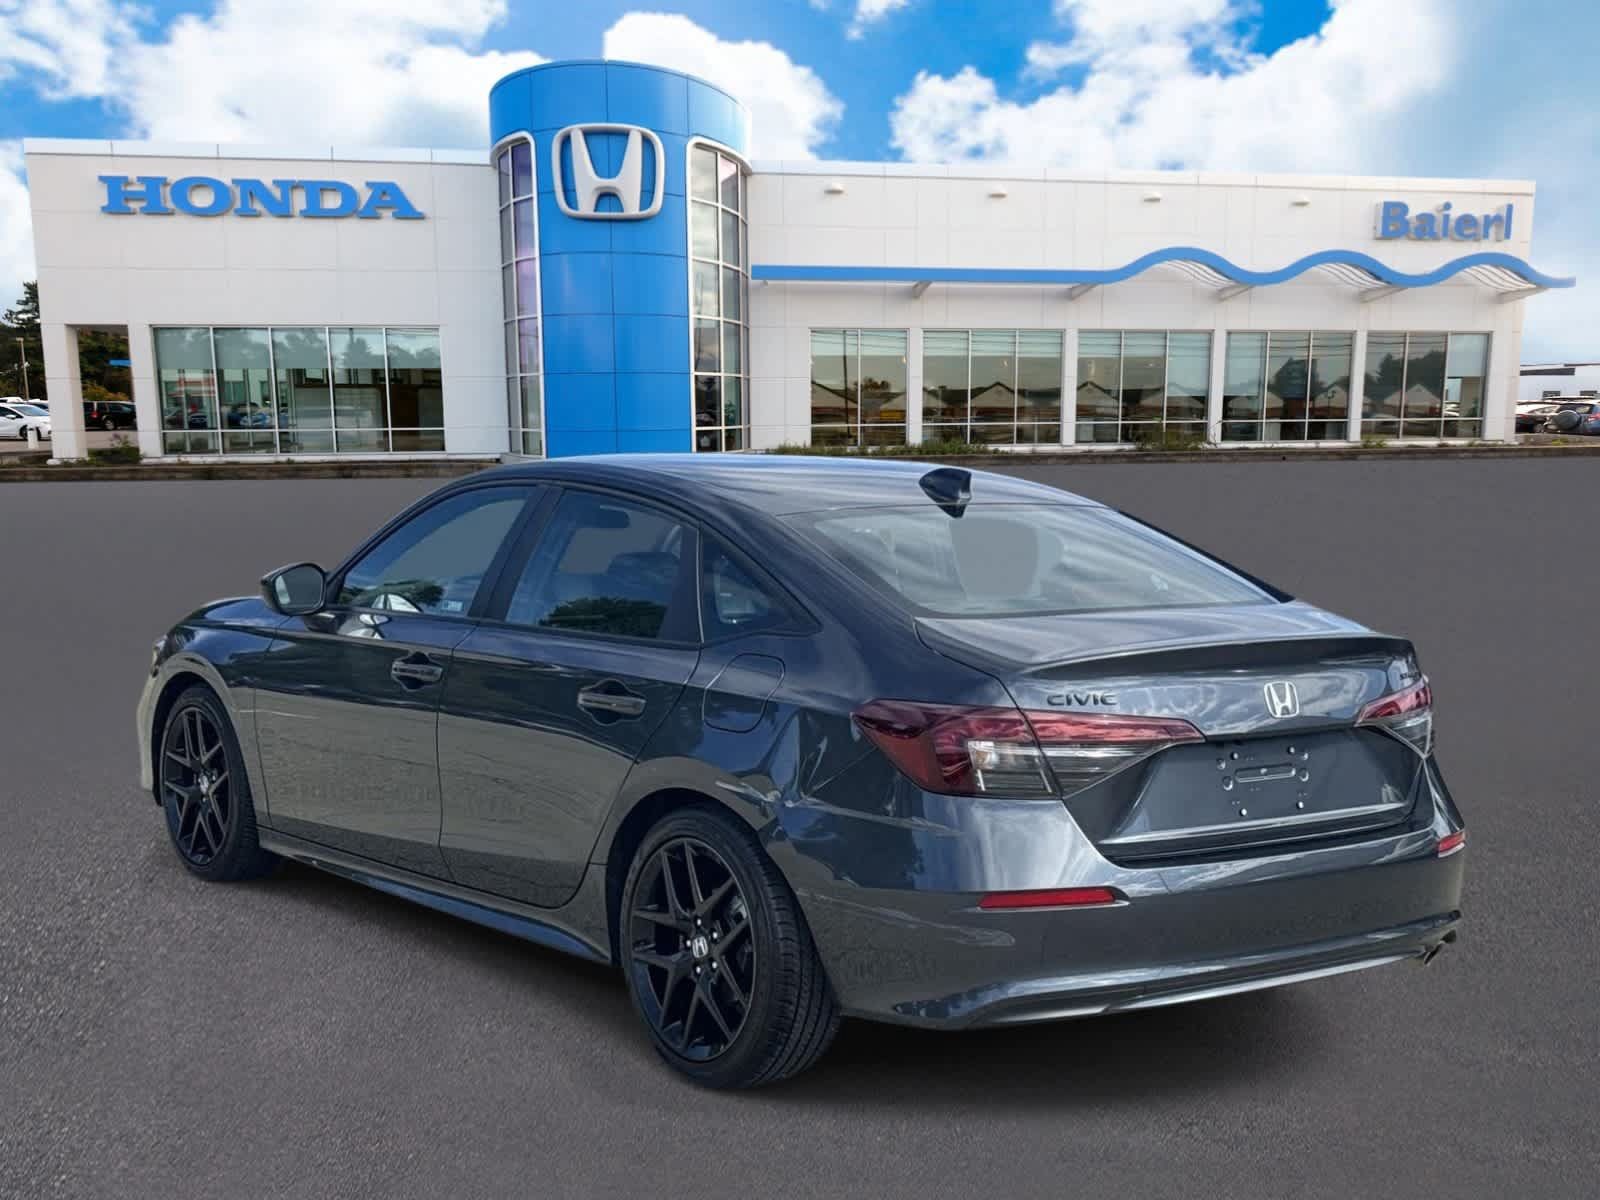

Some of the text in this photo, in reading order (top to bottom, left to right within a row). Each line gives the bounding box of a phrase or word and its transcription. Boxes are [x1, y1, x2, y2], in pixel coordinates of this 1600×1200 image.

[97, 175, 425, 219] HONDA
[1380, 200, 1514, 240] Baierl
[1047, 694, 1118, 706] CIVIC
